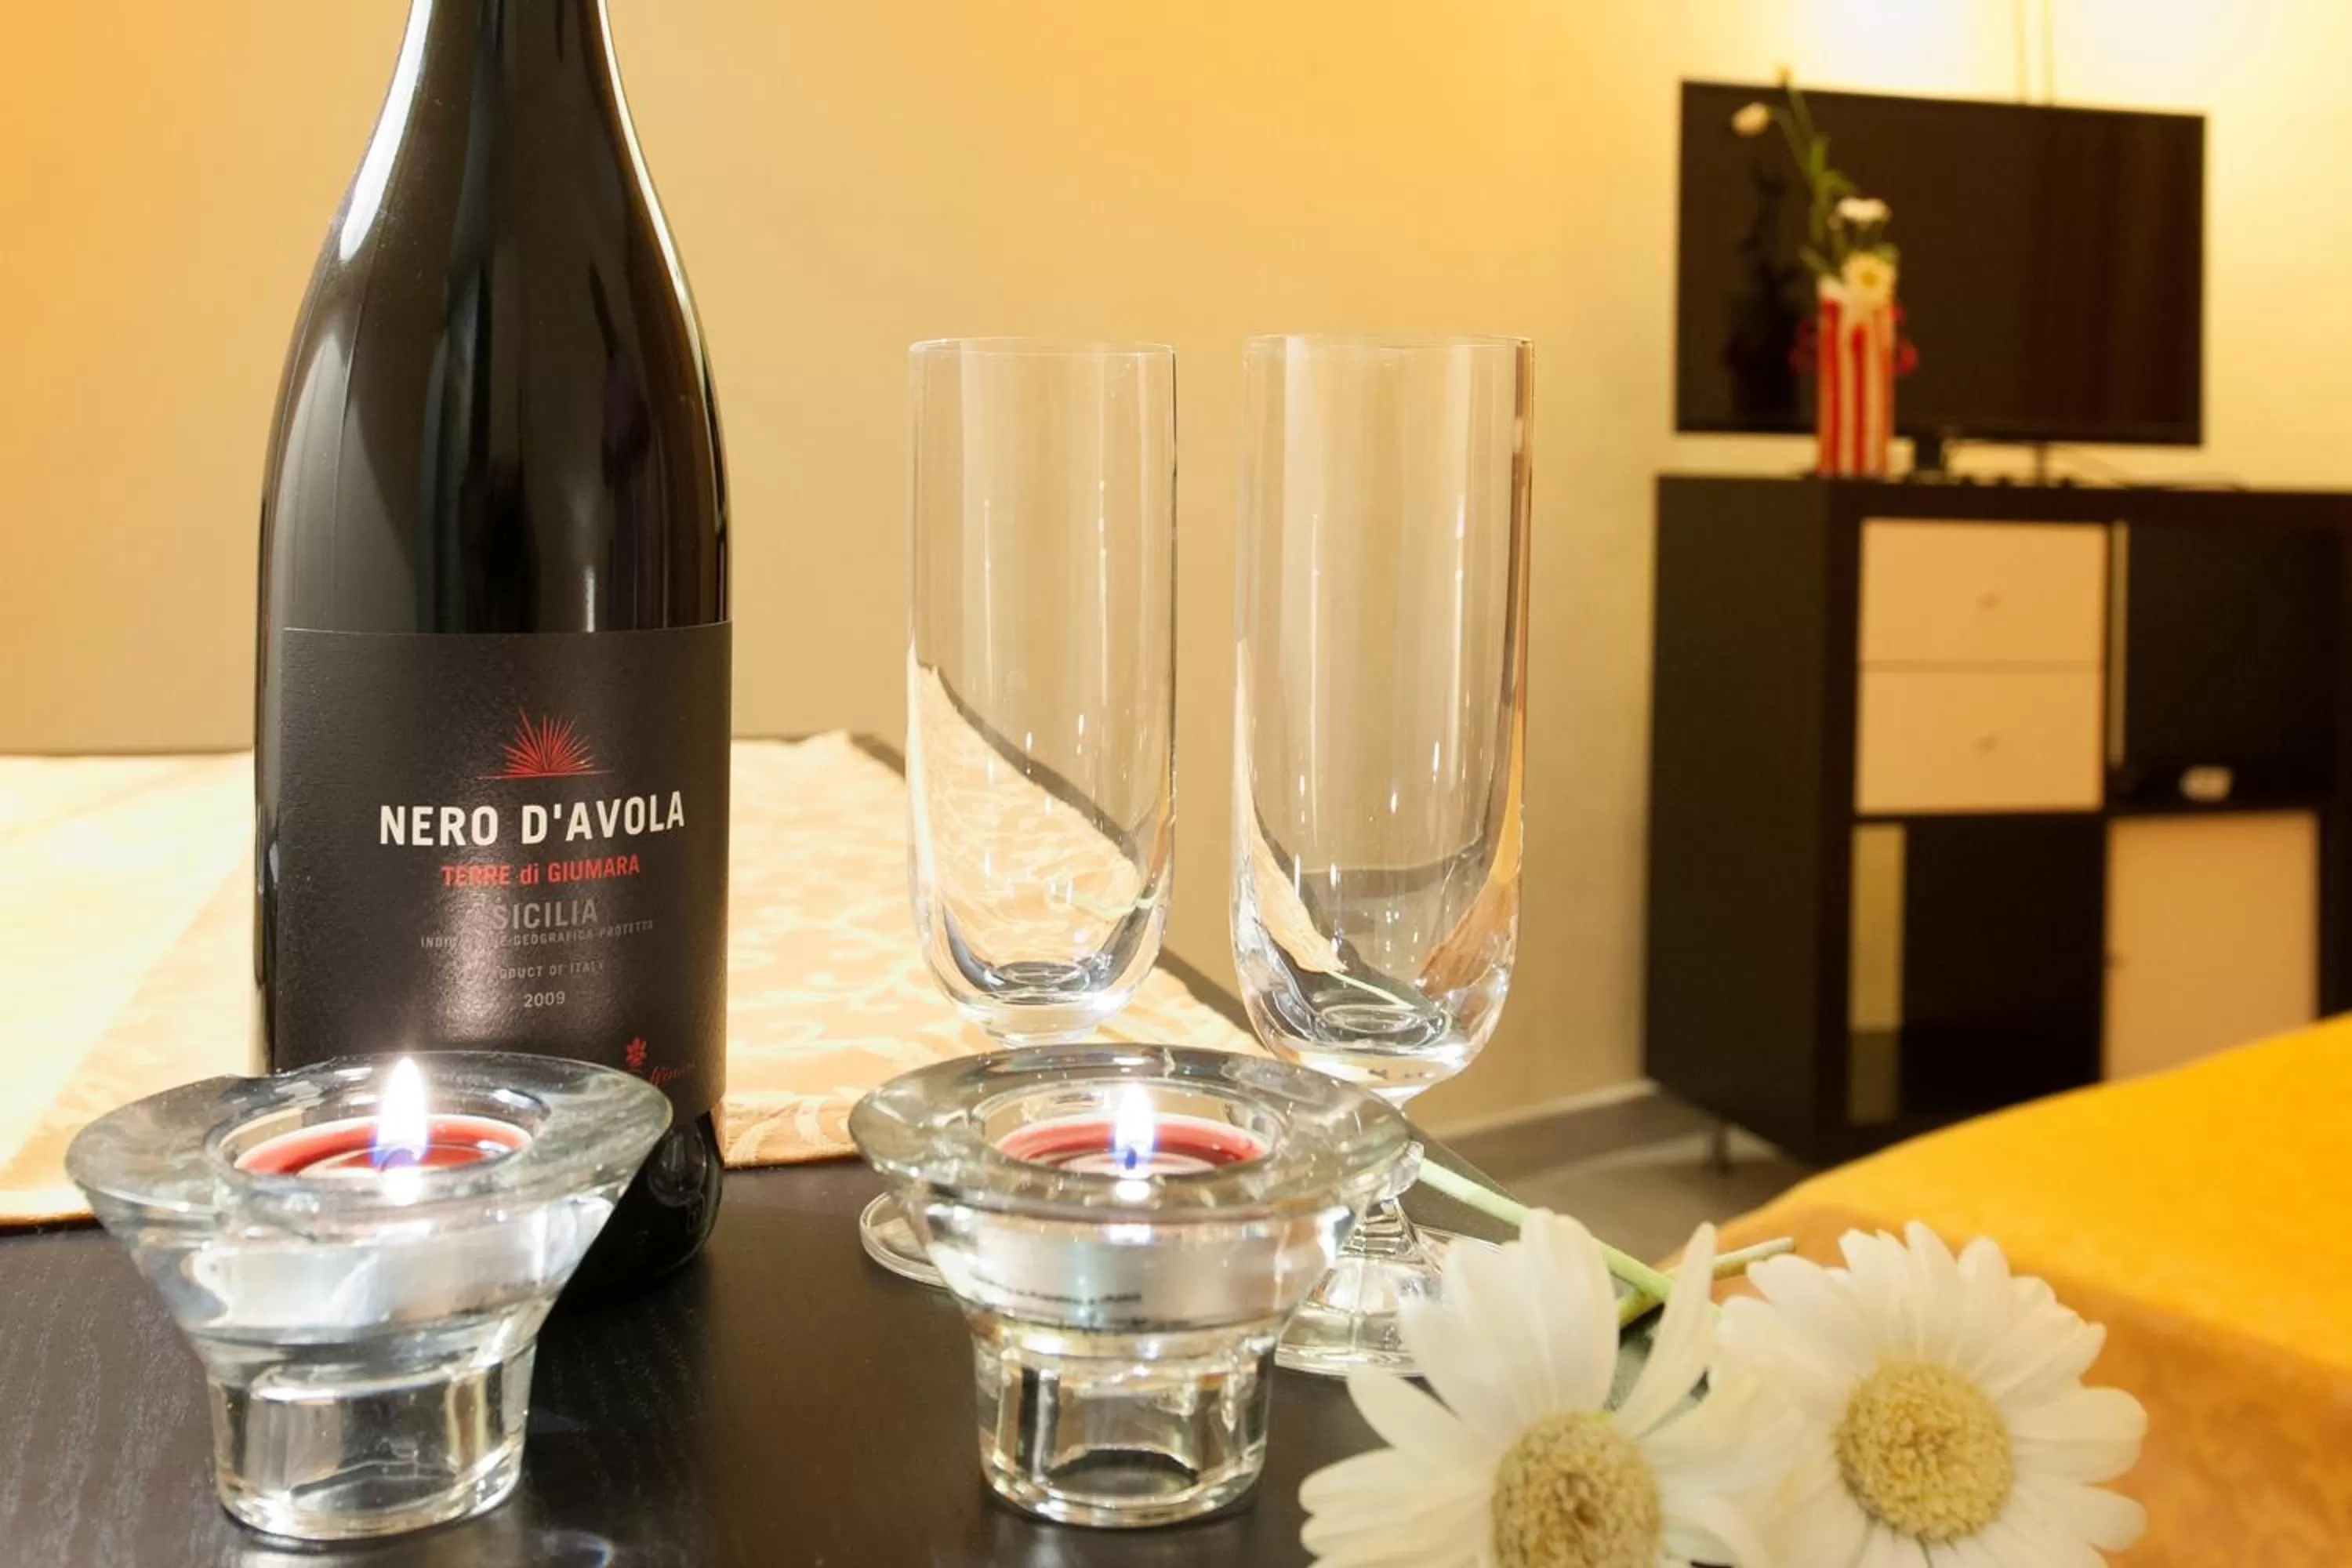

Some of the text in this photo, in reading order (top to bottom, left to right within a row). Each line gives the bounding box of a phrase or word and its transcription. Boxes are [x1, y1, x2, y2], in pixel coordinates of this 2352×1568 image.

[379, 790, 684, 846] NERO D'AVOLA
[441, 853, 640, 887] TERRE di GIUMARA
[492, 899, 598, 930] SICILIA
[523, 990, 566, 1008] 2009
